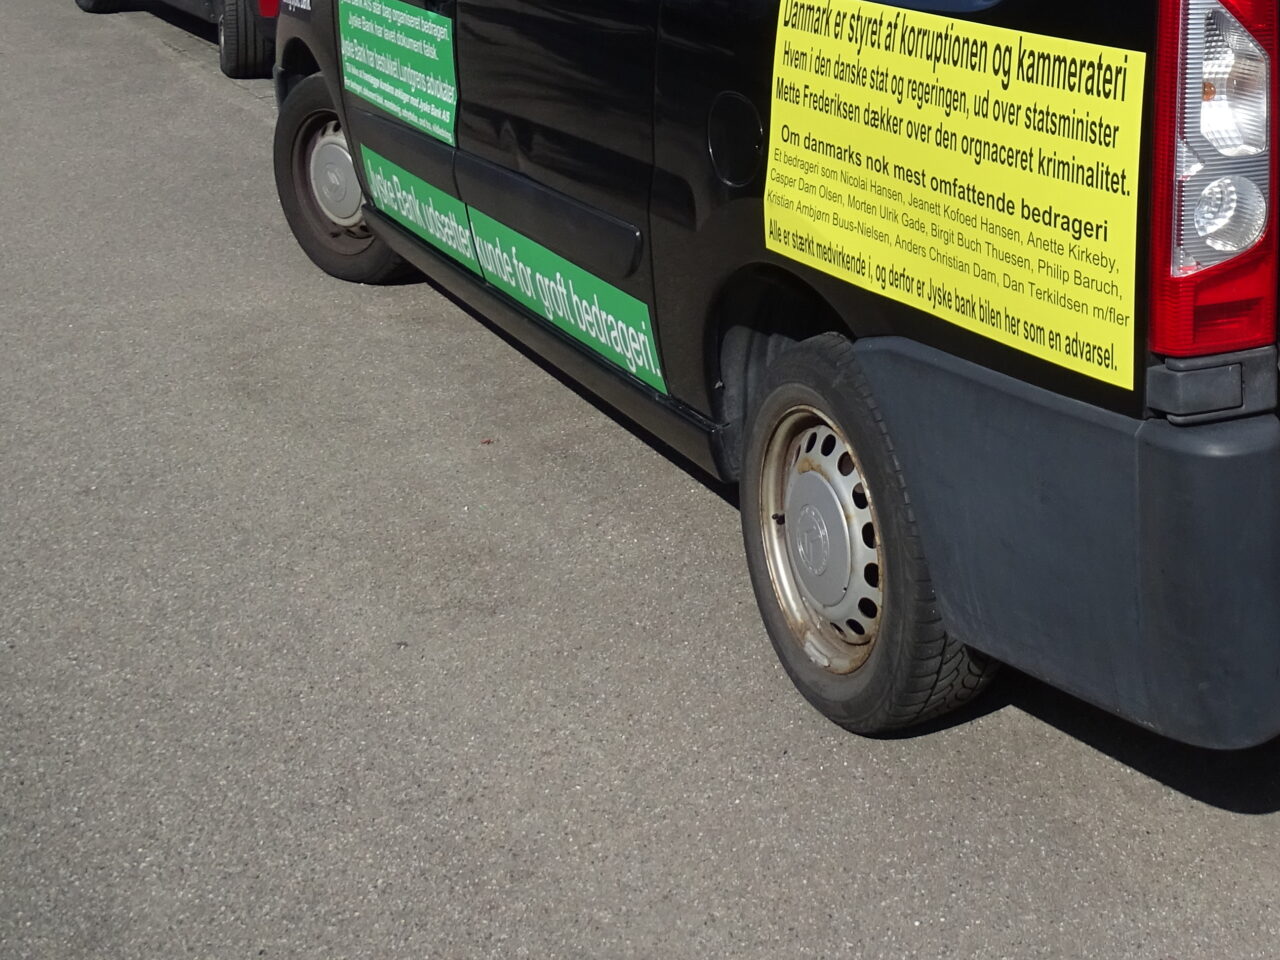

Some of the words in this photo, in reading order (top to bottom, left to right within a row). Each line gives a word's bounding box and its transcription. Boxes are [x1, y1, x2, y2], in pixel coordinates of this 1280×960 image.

[833, 10, 847, 39] er
[847, 7, 883, 55] styret
[884, 11, 900, 52] af
[899, 13, 987, 73] korruptionen
[992, 43, 1012, 90] og
[1016, 35, 1127, 101] kammerateri
[773, 147, 781, 162] Et
[783, 150, 818, 174] bedrageri
[820, 166, 838, 180] som
[840, 169, 867, 190] Nicolai
[870, 179, 905, 204] Hansen,
[907, 192, 940, 216] Jeanett
[943, 203, 976, 228] Kofoed
[980, 215, 1023, 245] Hansen,
[1026, 231, 1064, 255] Anette
[1068, 242, 1118, 273] Kirkeby,
[781, 124, 799, 146] Om
[803, 132, 861, 166] danmarks
[866, 155, 889, 176] nok
[893, 164, 926, 188] mest
[930, 176, 1014, 215] omfattende
[1021, 197, 1107, 241] bedrageri
[367, 159, 398, 210] Jyske
[392, 174, 426, 229] Bank
[421, 197, 474, 259] udsætter
[470, 221, 515, 286] kunde
[511, 246, 536, 299] for
[535, 271, 574, 324] groft
[568, 279, 661, 376] bedrageri.
